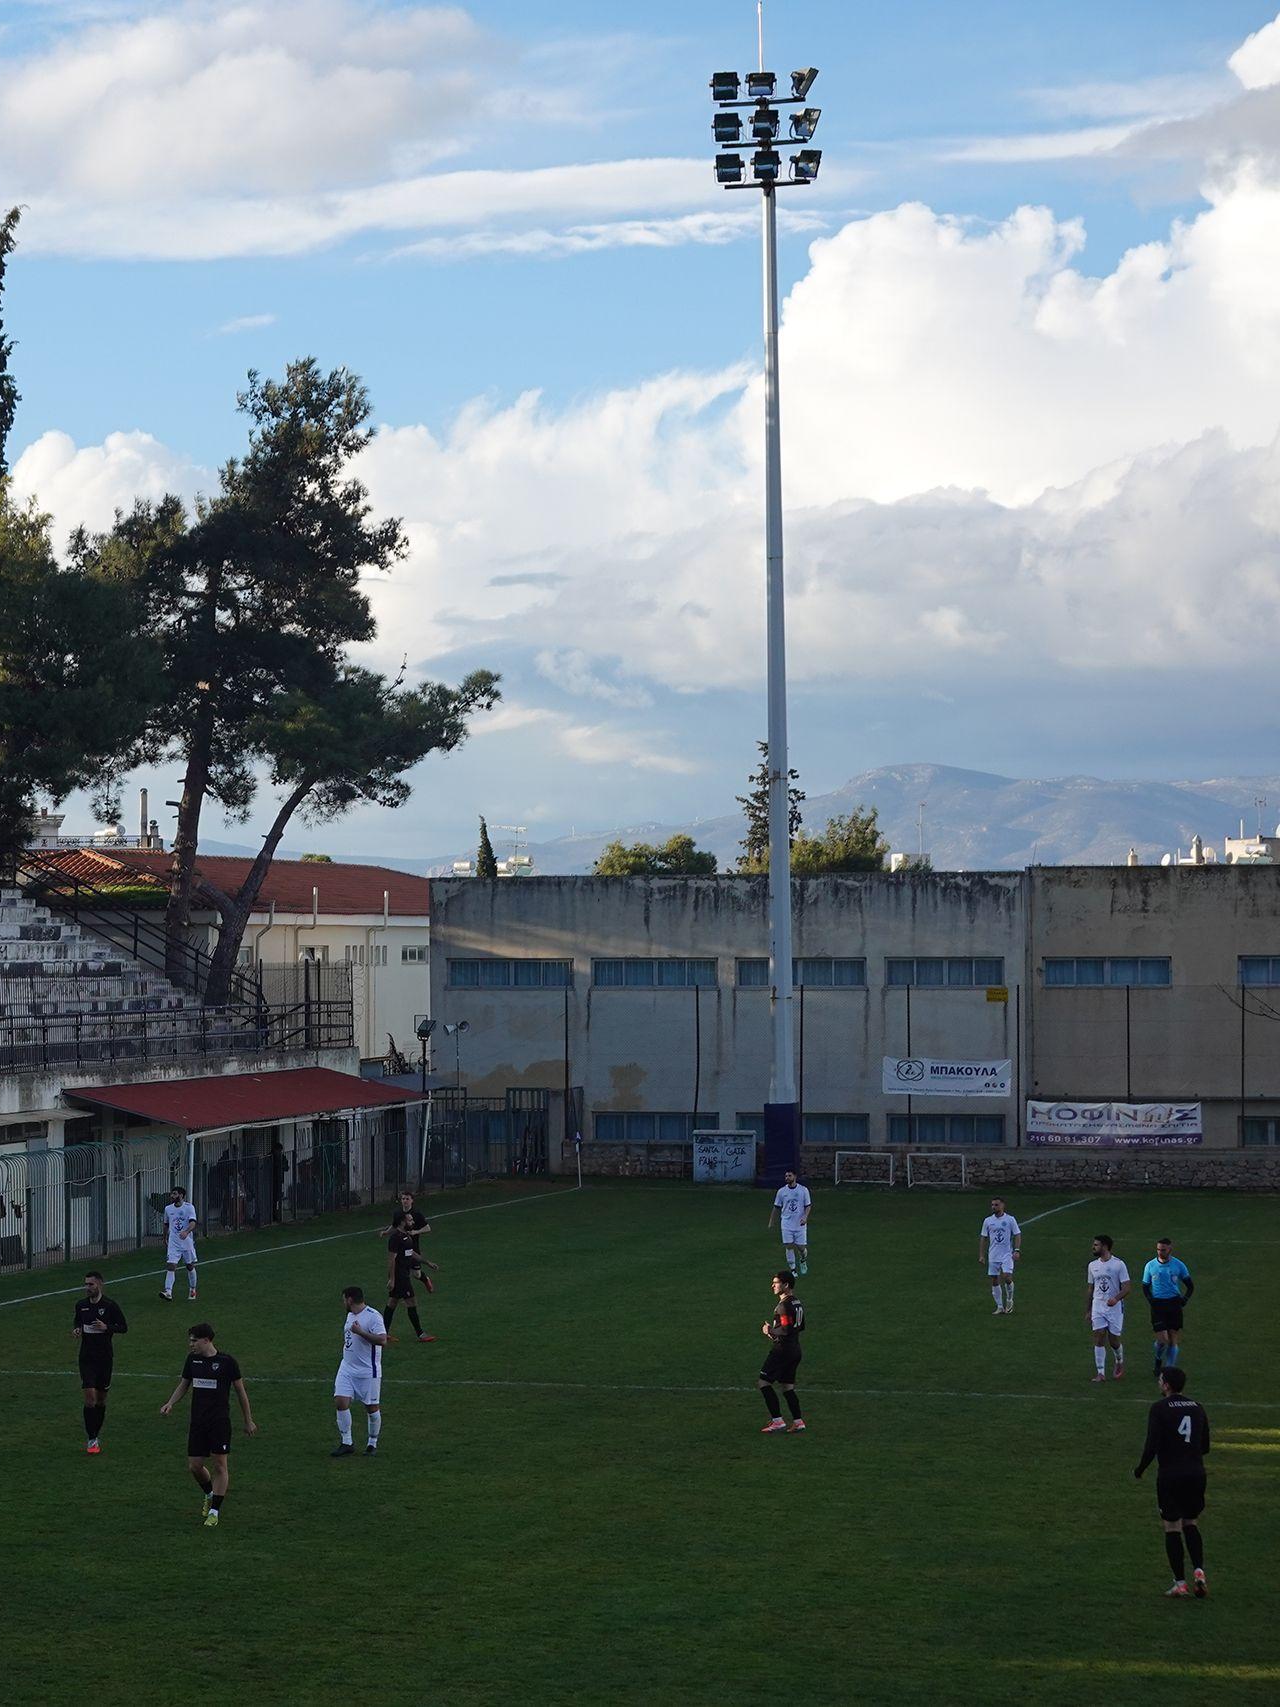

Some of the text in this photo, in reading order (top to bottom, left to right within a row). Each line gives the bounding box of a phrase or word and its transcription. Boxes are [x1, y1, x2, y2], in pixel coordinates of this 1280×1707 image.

[930, 1065, 998, 1076] ΜΠΑΚΟΥΛΑ
[1114, 1136, 1199, 1145] www.kofinas.gr
[793, 1306, 803, 1328] 10
[1177, 1415, 1192, 1442] 4
